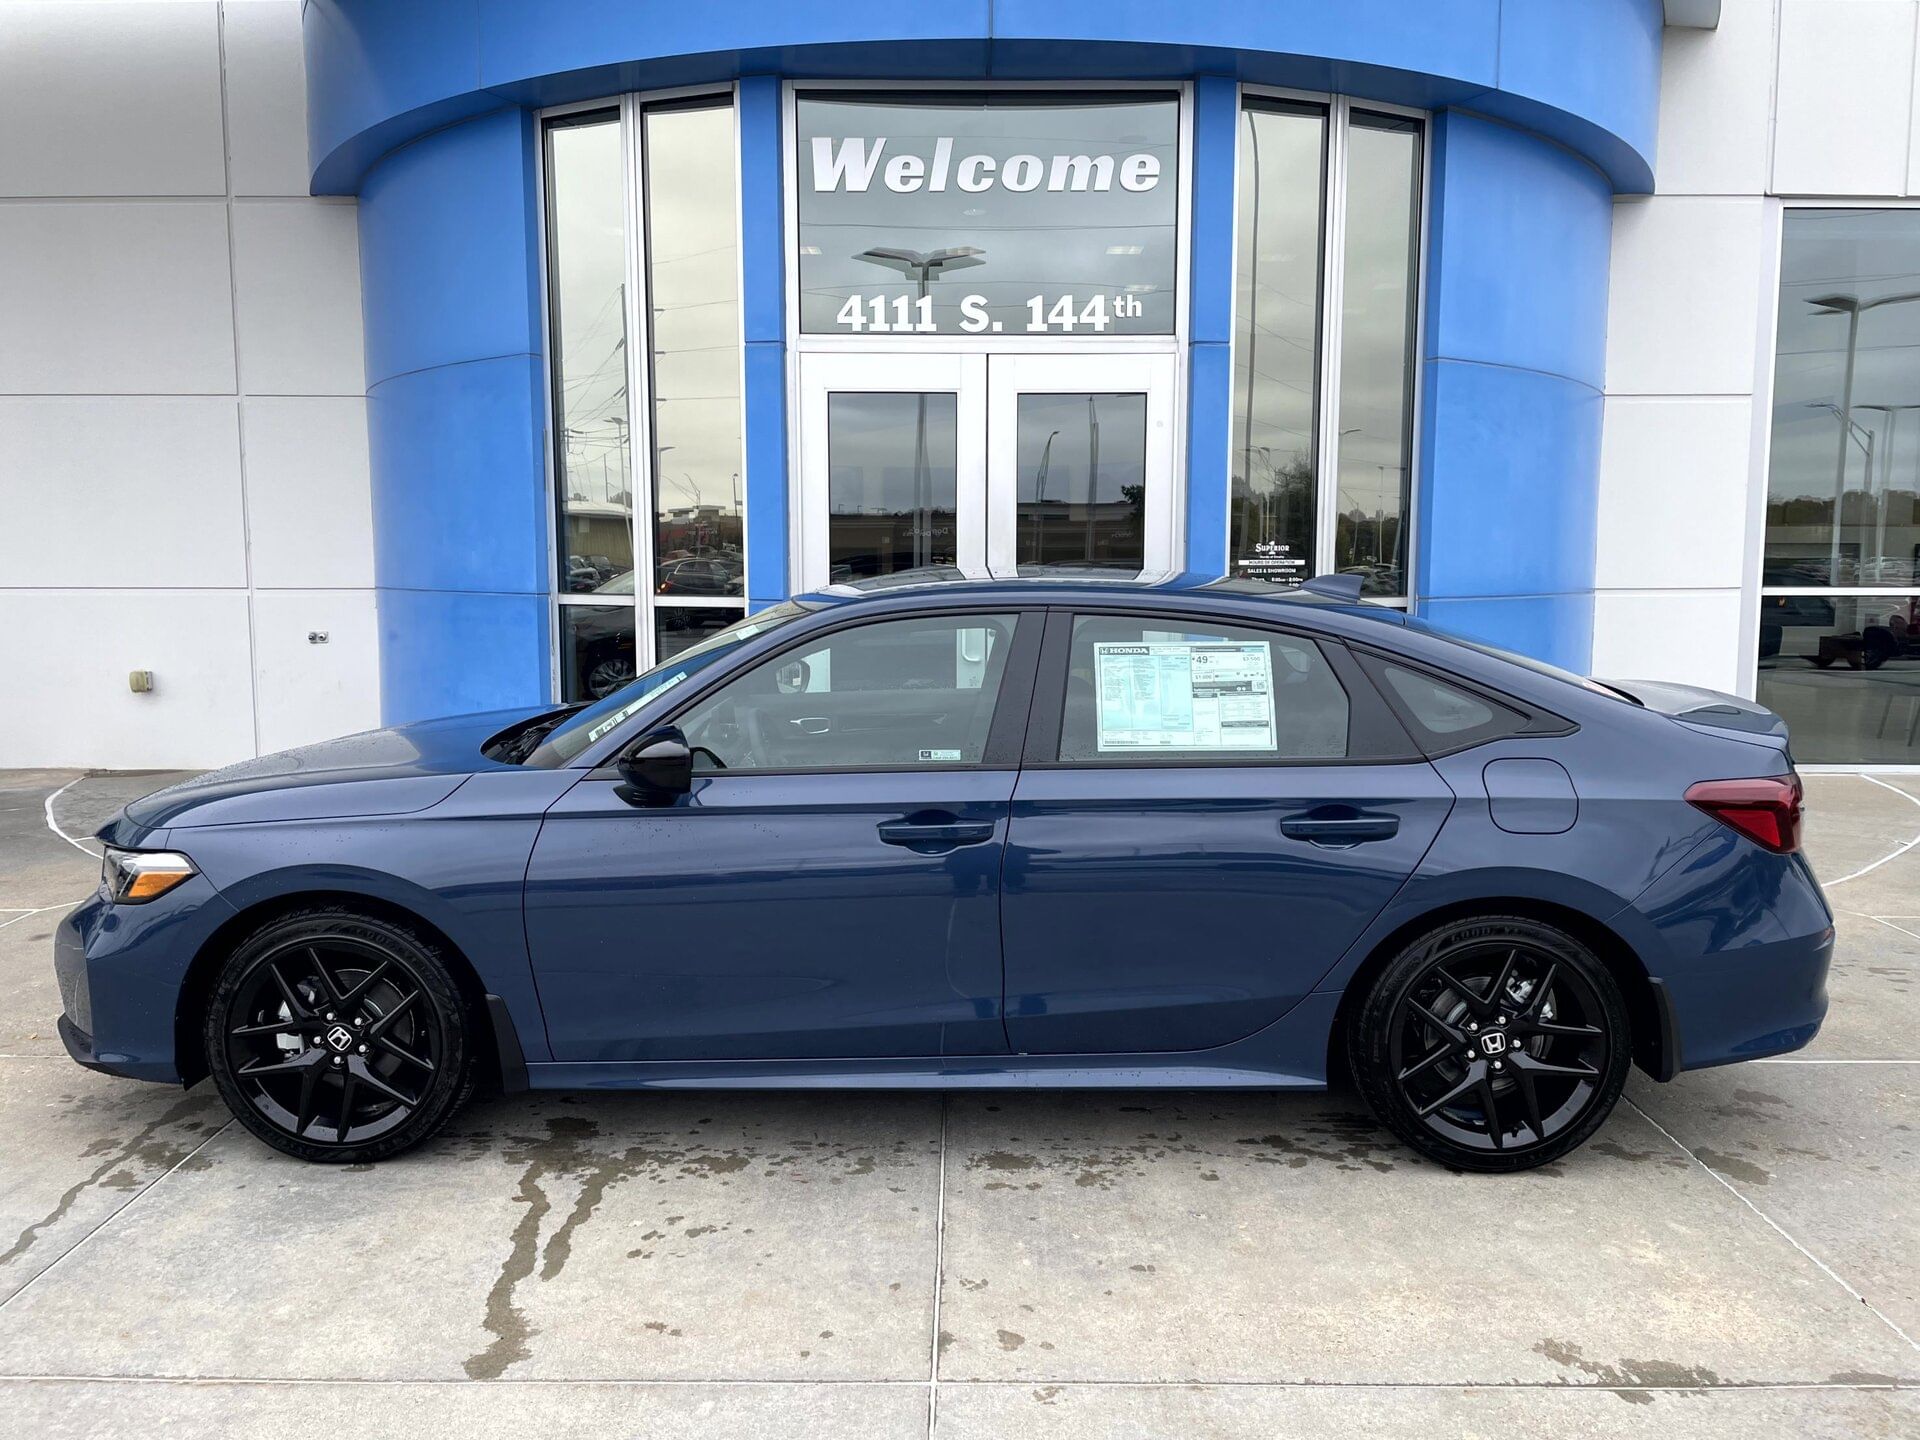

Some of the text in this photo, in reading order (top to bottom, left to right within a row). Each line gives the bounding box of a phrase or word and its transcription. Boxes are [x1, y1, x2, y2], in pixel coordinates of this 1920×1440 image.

[812, 137, 1160, 193] Welcome
[837, 294, 937, 332] 4111
[959, 294, 1003, 333] S.
[1196, 656, 1209, 664] 49
